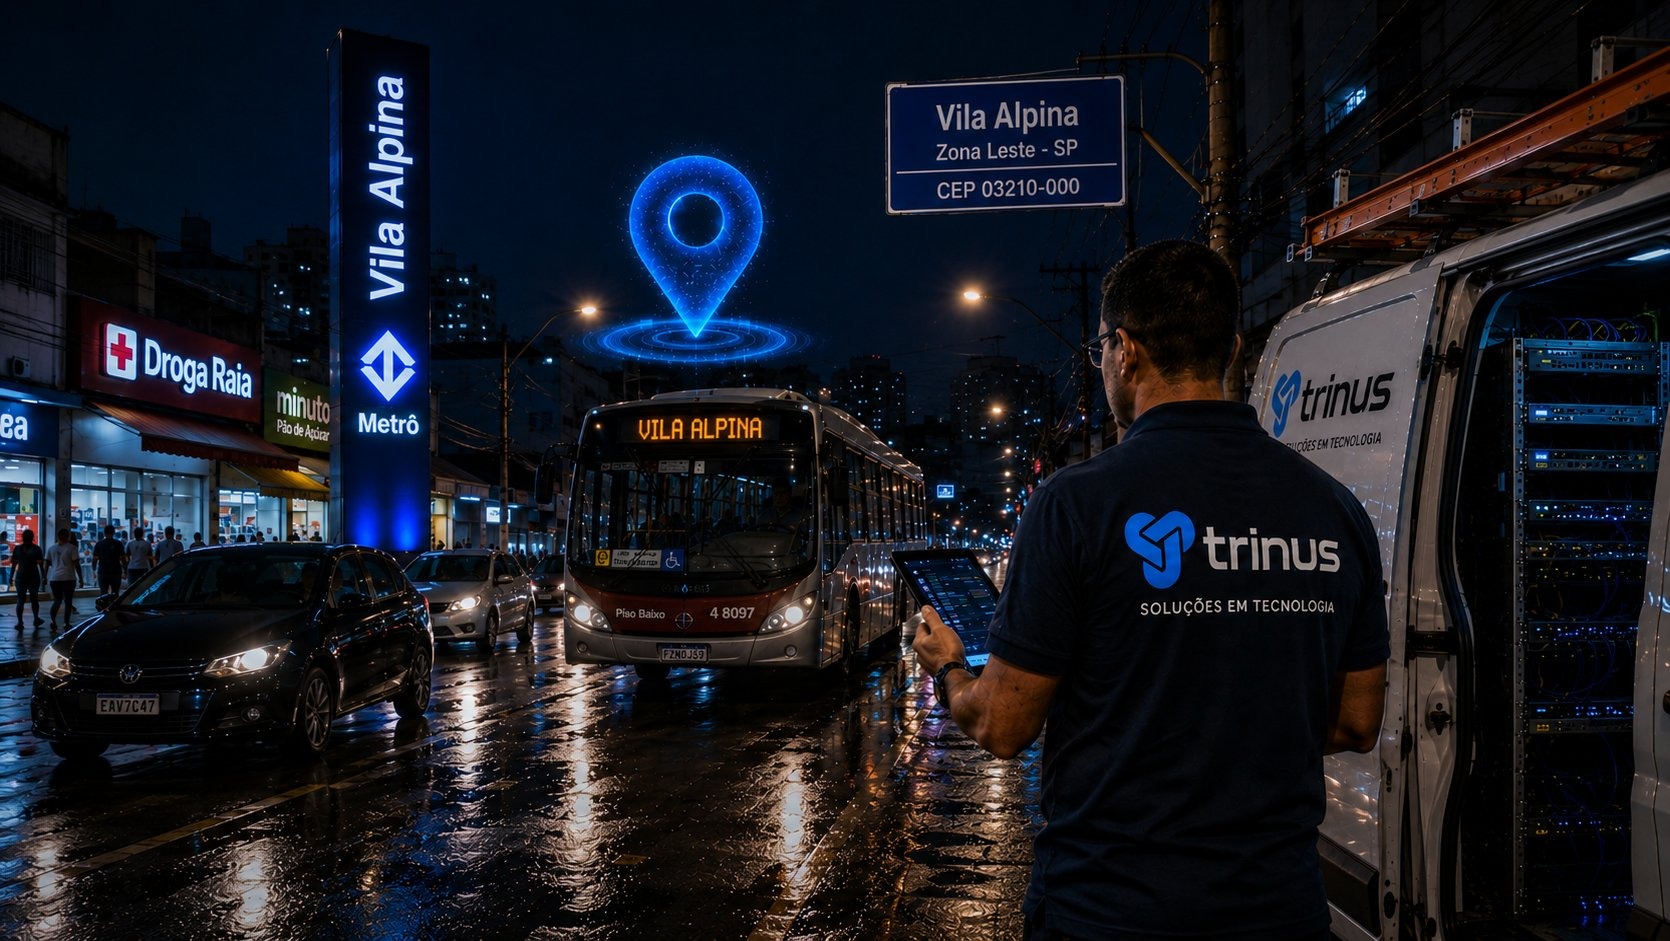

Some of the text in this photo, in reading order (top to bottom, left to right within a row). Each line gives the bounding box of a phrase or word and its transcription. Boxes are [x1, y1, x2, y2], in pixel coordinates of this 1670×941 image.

[936, 100, 1079, 135] Vila Alpina
[936, 143, 981, 161] Zona
[987, 142, 1035, 159] Leste
[1053, 139, 1078, 157] SP
[368, 75, 413, 300] Vila Alpina
[936, 177, 1080, 199] CEP 03210-000
[144, 337, 252, 398] Droga Raia
[276, 386, 331, 424] minuto
[1300, 372, 1395, 422] trinus
[276, 418, 293, 434] Pão
[293, 422, 305, 437] de
[358, 413, 420, 434] Metrô
[638, 417, 762, 440] VILA ALPINA
[1317, 439, 1329, 451] EM
[1329, 432, 1382, 449] TECNOLOGIA
[1203, 526, 1341, 573] trinus
[615, 608, 666, 620] Piso Baixo
[709, 607, 755, 619] 4 8097
[1140, 597, 1335, 617] SOLUÇÕES EM TECNOLOGIA
[100, 699, 155, 713] EAV7C47
